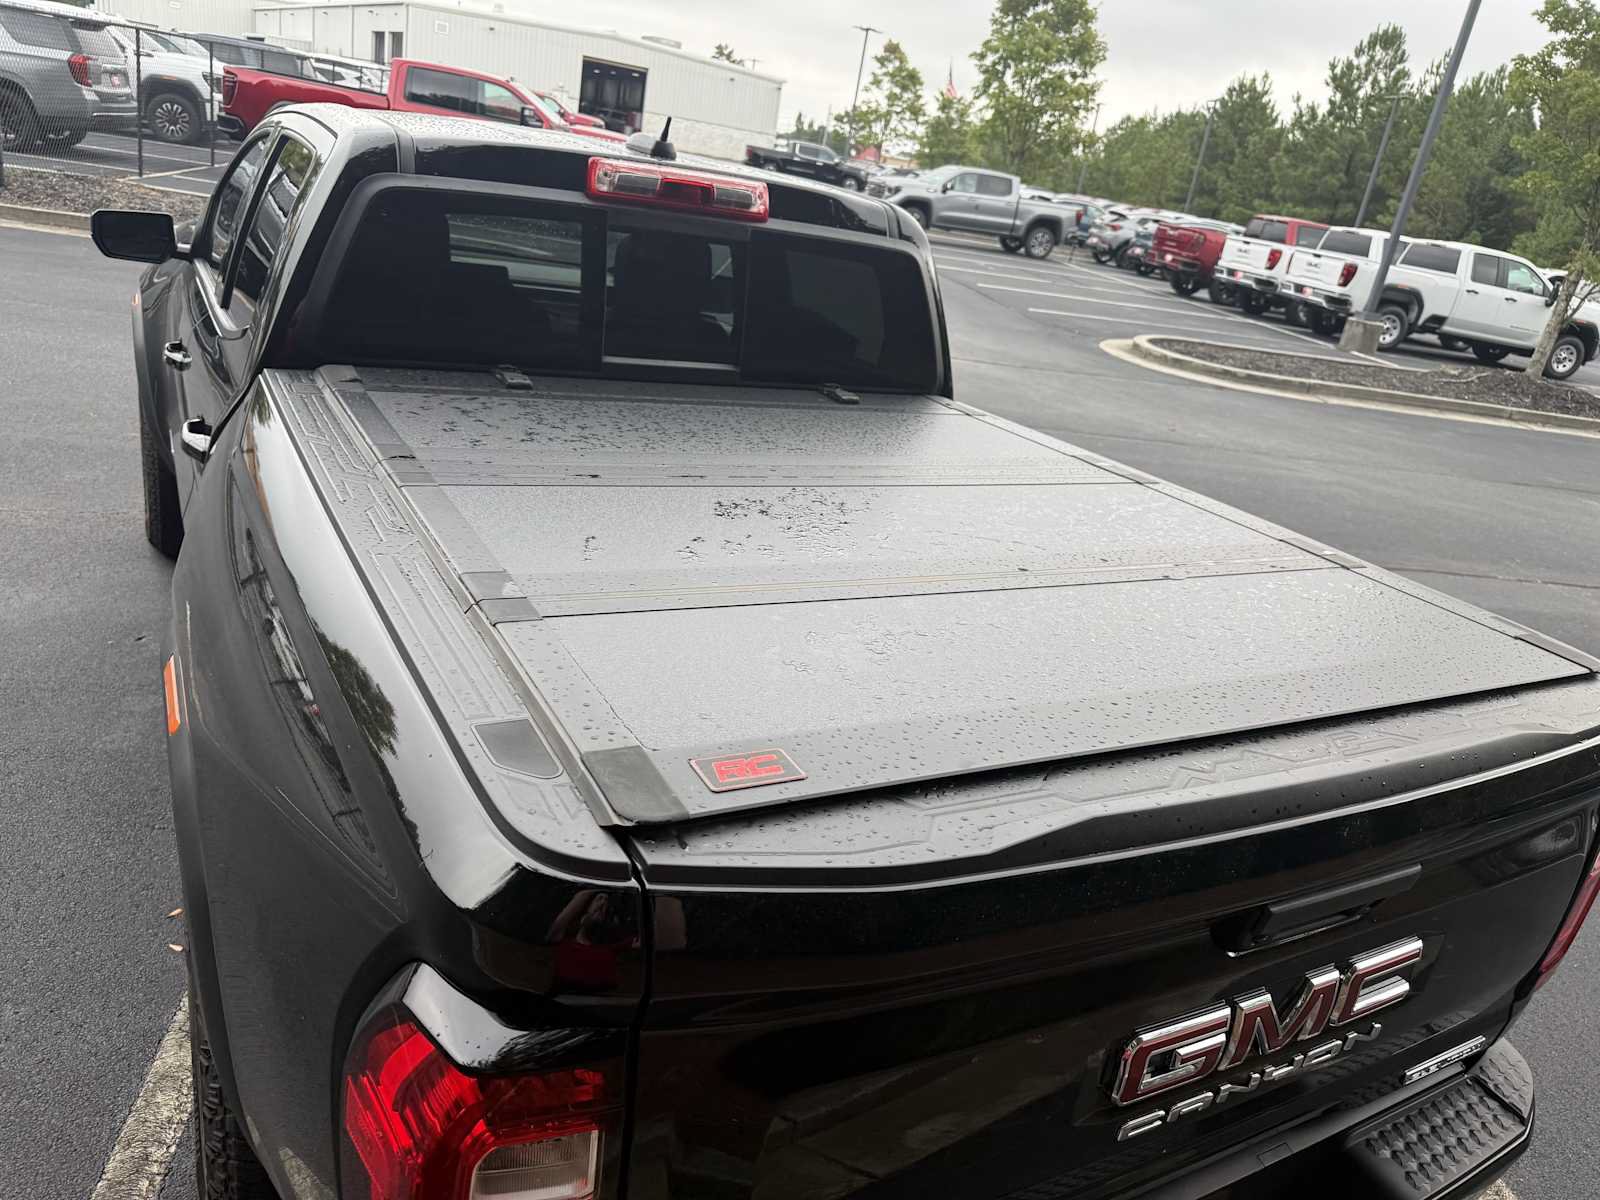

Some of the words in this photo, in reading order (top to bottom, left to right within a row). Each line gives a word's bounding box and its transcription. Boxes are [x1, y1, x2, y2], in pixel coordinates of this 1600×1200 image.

[712, 754, 785, 783] RC
[1111, 936, 1424, 1107] GMC
[1117, 1022, 1382, 1142] CANYON
